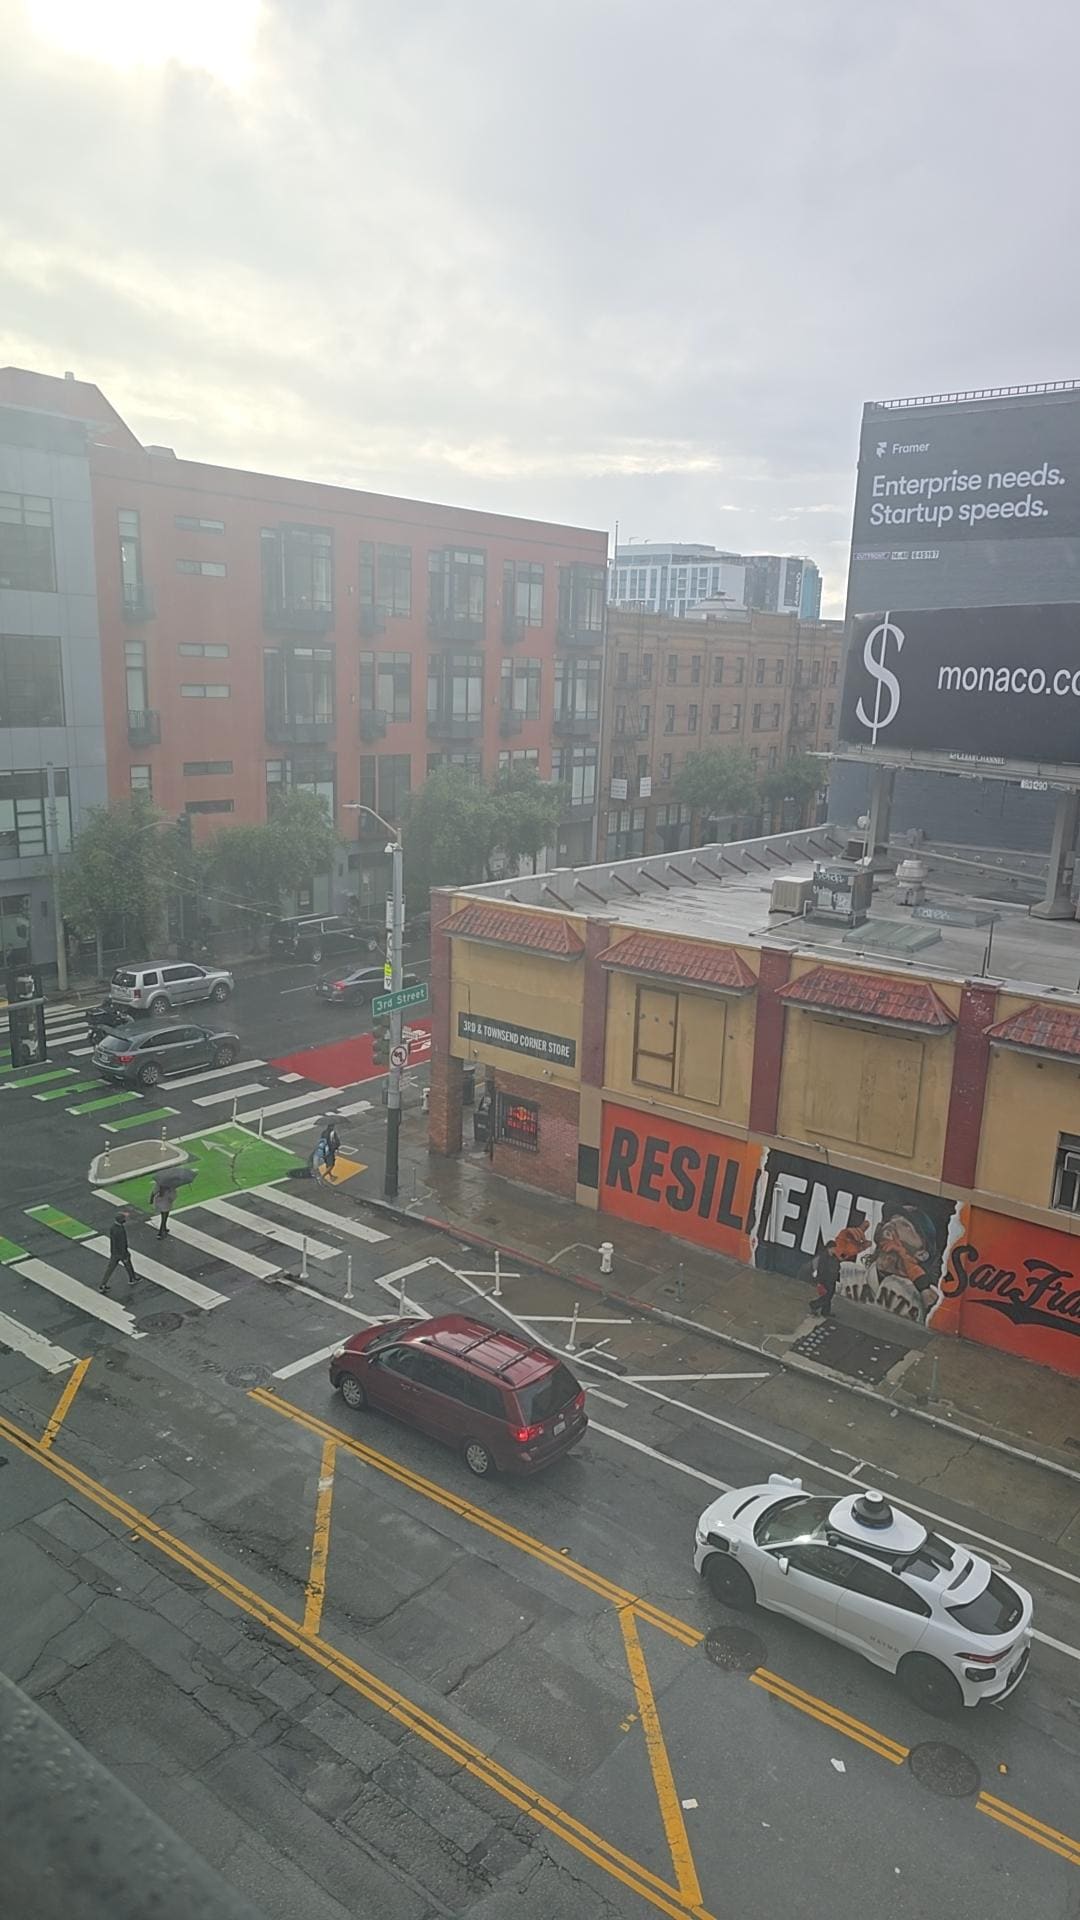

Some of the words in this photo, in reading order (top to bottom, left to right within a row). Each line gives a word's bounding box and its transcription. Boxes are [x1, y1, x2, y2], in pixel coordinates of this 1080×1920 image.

[892, 442, 930, 454] Framer
[872, 469, 981, 499] Enterprise
[987, 462, 1065, 489] needs.
[870, 503, 953, 527] Startup
[958, 494, 1049, 526] speeds.
[376, 998, 393, 1011] 3rd
[396, 989, 425, 1004] Street
[463, 1020, 476, 1033] 3RD
[477, 1024, 483, 1035] &
[484, 1025, 519, 1045] TOWNSEND
[519, 1035, 547, 1052] CORNER
[548, 1042, 571, 1058] STORE
[943, 1244, 1024, 1298] San
